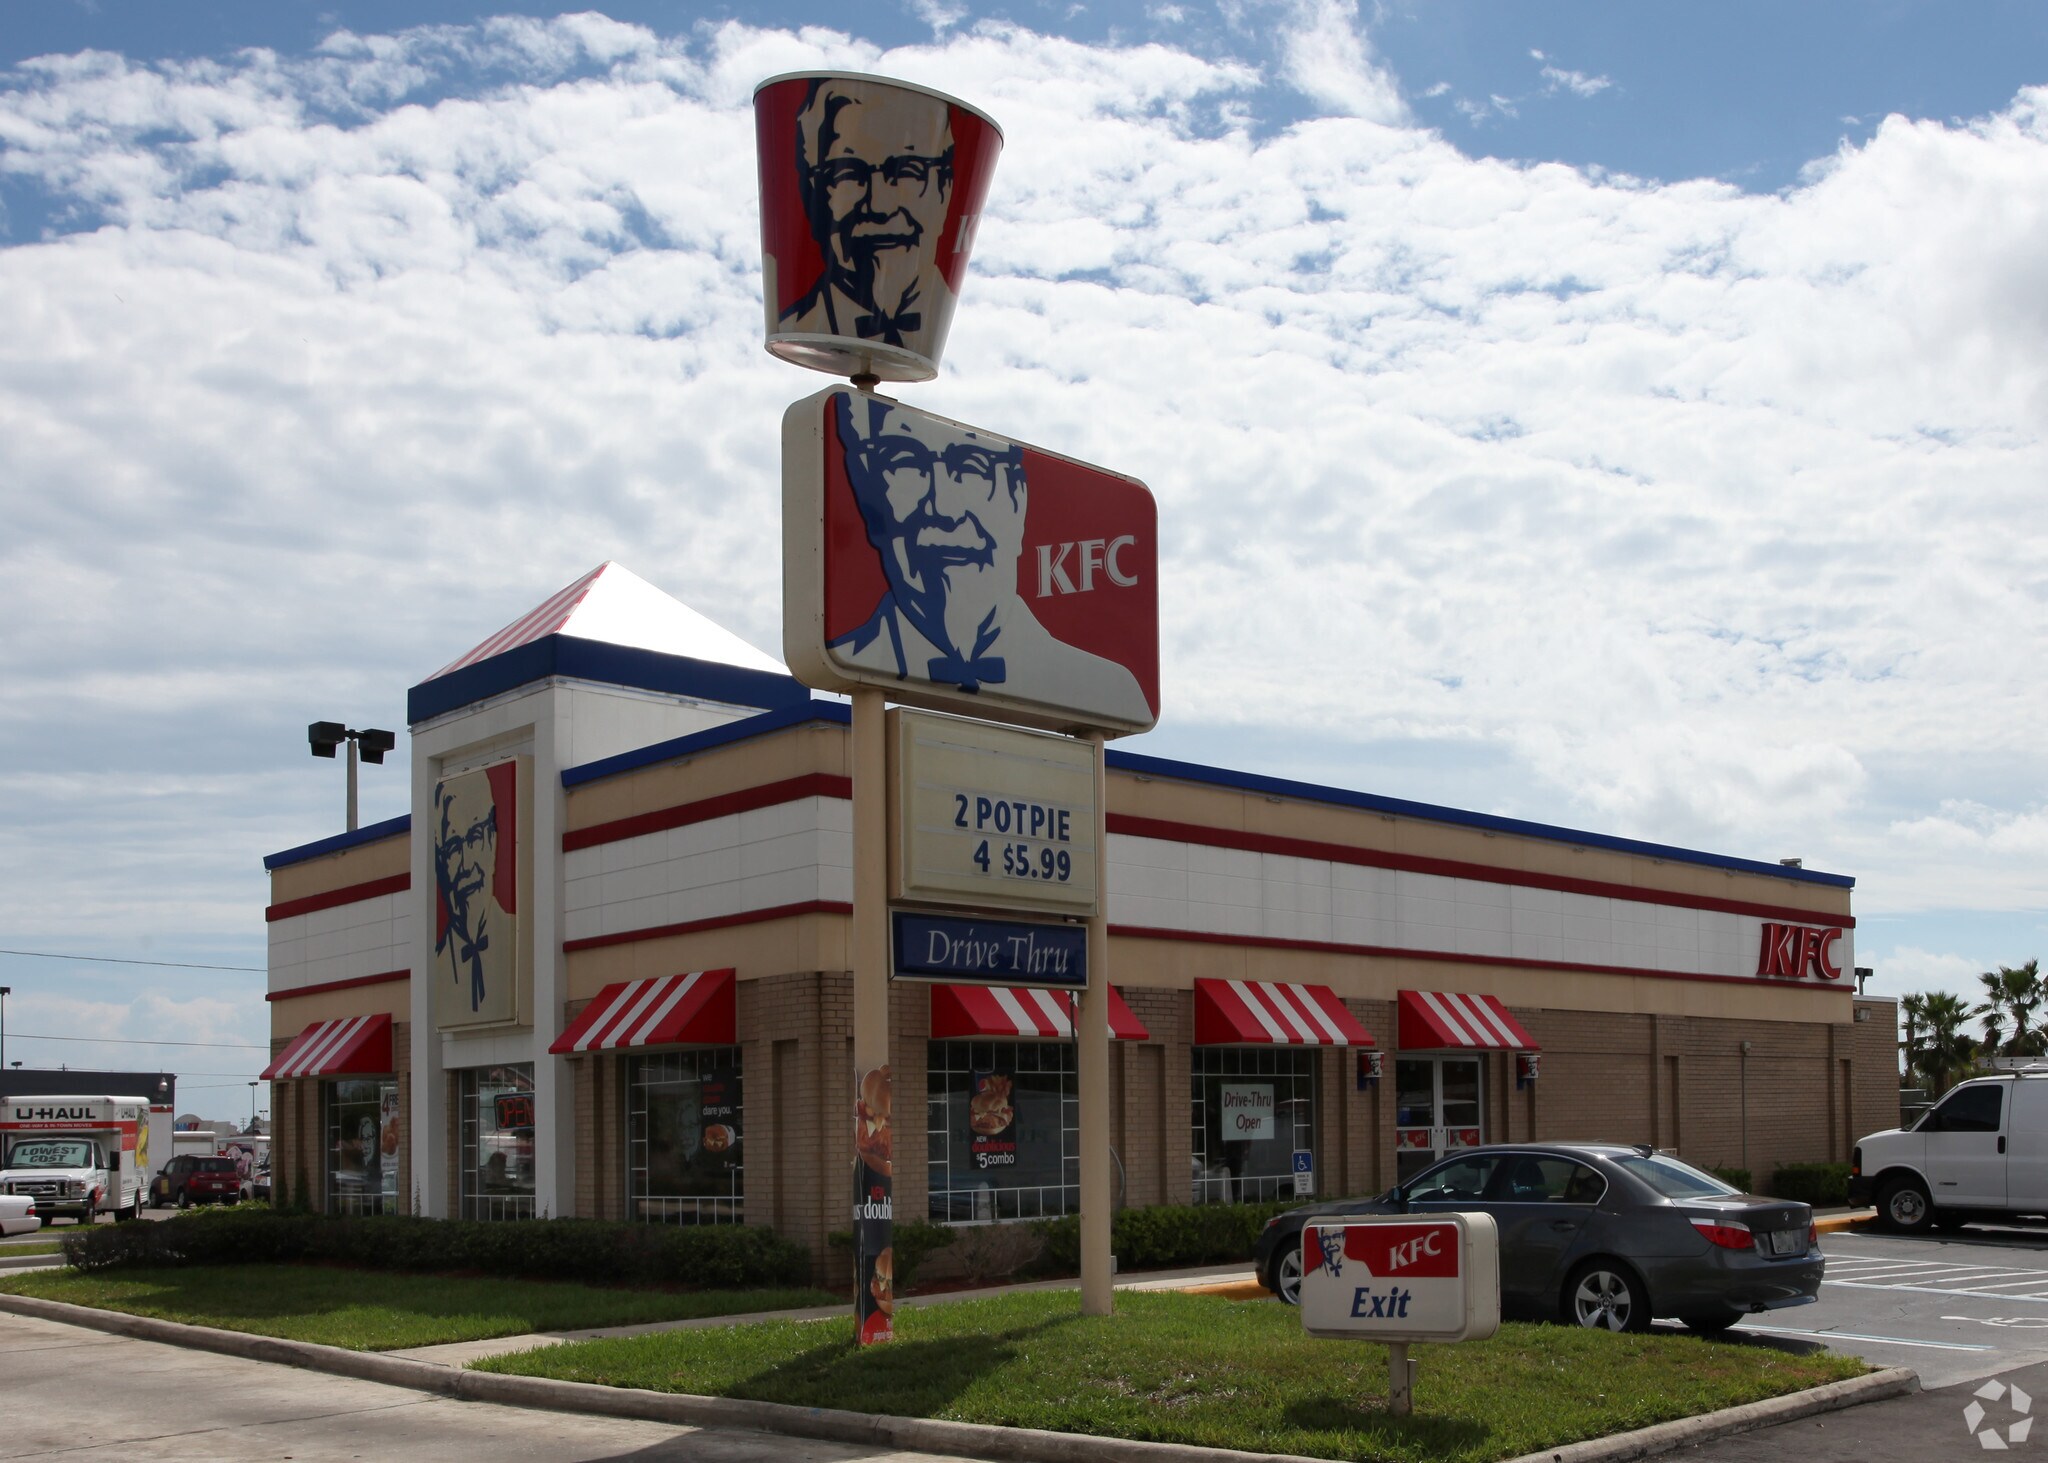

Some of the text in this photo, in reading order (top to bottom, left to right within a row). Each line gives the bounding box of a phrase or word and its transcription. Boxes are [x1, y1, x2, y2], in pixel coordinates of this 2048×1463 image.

[1036, 534, 1138, 598] KFC
[955, 794, 1070, 841] 2 POTPIE
[973, 839, 1071, 881] 4 $5.99
[926, 928, 1069, 974] Drive Thru
[1756, 922, 1842, 980] KFC
[16, 1107, 96, 1120] U-HAUL
[497, 1097, 535, 1127] OPEN
[1224, 1091, 1271, 1108] Drive-Thru
[1235, 1114, 1261, 1132] Open
[21, 1147, 78, 1156] LOWEST
[29, 1155, 66, 1163] COST
[987, 1152, 1015, 1165] combo
[1389, 1230, 1441, 1271] KFC
[1350, 1287, 1411, 1318] Exit
